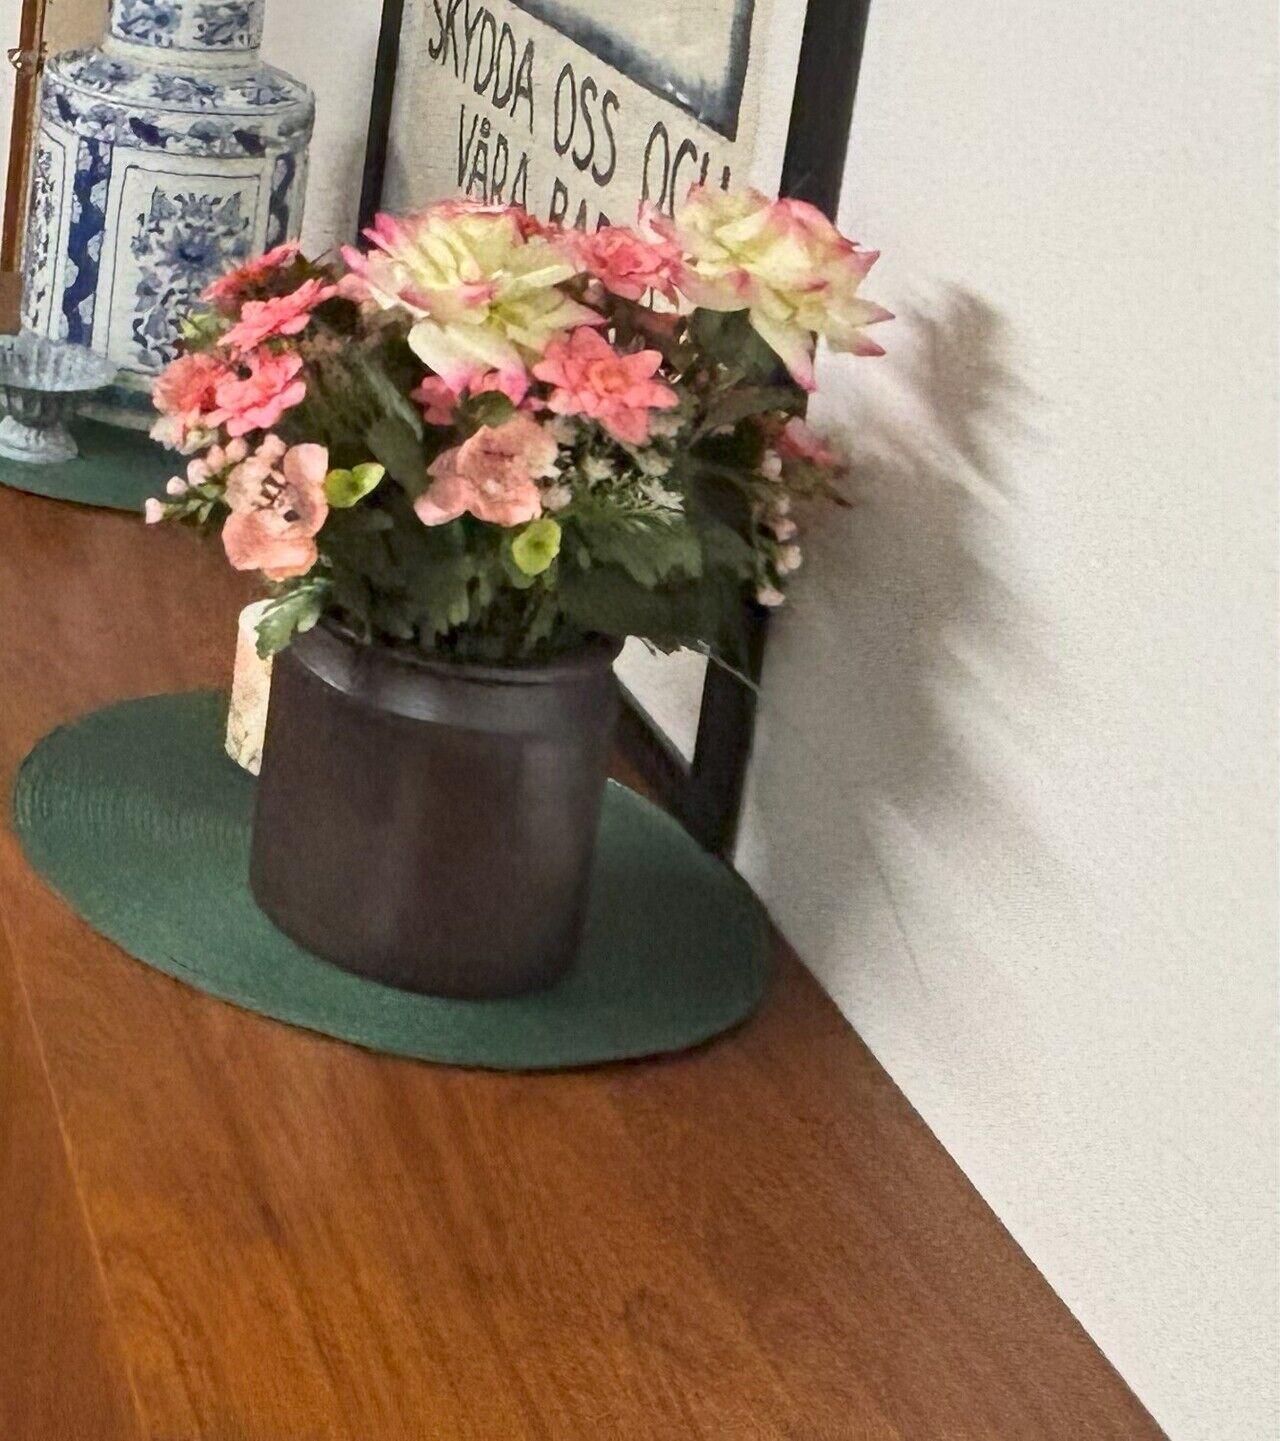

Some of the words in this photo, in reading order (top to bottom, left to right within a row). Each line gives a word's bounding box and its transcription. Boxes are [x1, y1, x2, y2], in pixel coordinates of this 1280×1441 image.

[456, 103, 529, 211] VÅRA
[553, 62, 619, 188] OSS
[640, 120, 731, 221] OC
